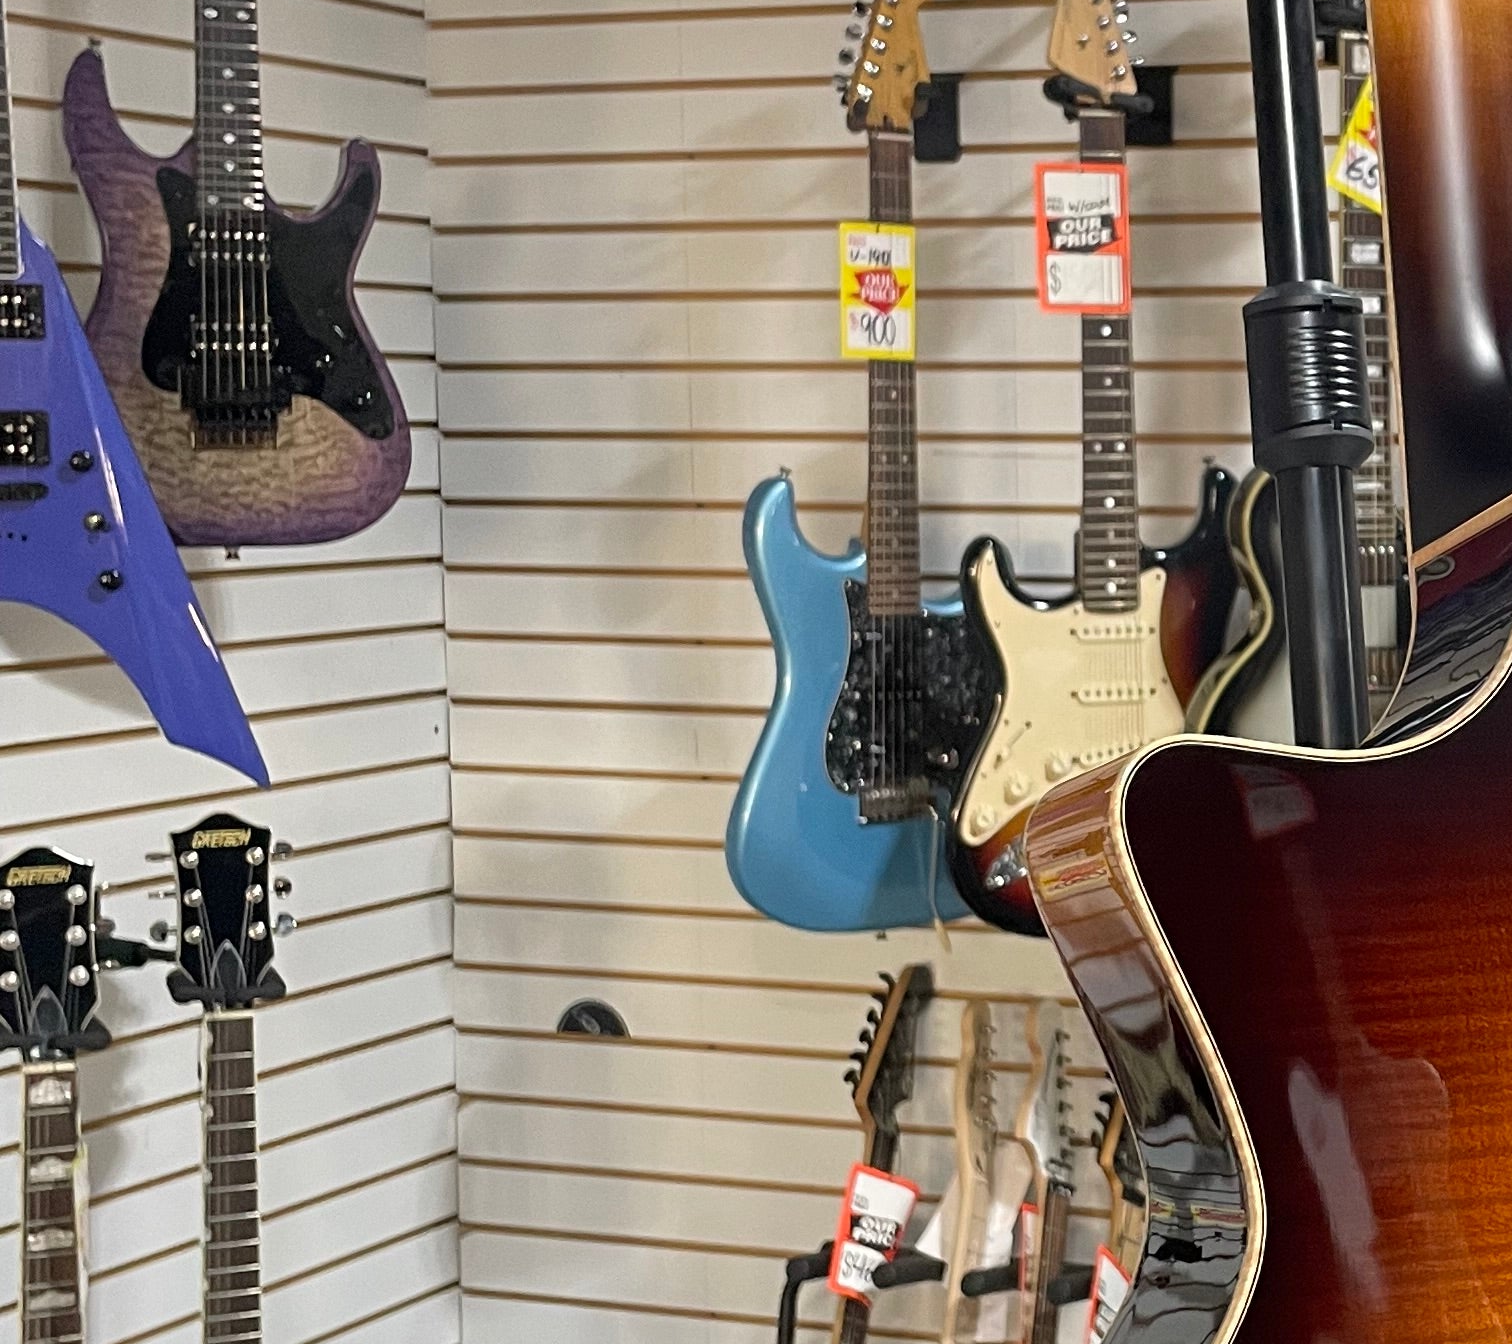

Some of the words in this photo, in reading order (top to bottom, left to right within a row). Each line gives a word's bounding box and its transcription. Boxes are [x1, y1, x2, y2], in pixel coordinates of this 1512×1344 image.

[1060, 217, 1102, 234] OUR
[1054, 231, 1111, 250] PRICE
[864, 273, 896, 289] OUR
[861, 286, 900, 302] PRICE
[191, 828, 251, 850] GRETSCH
